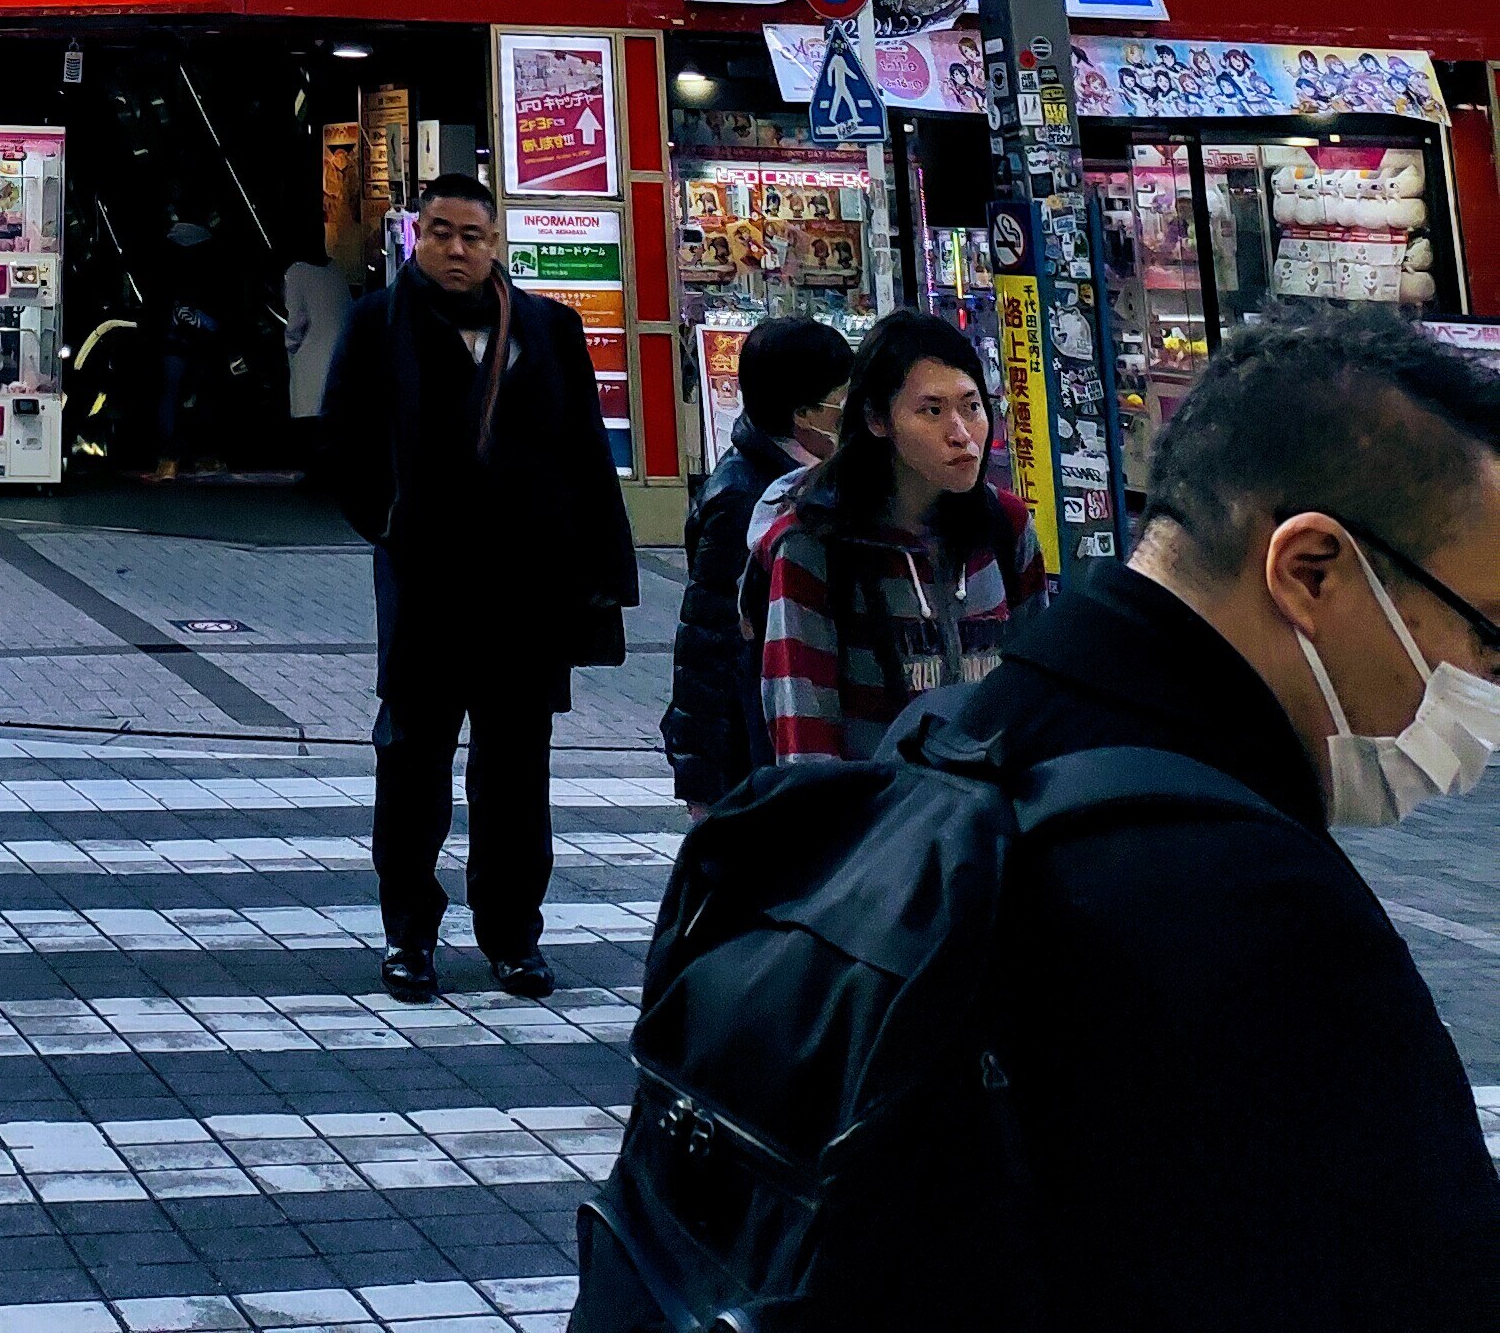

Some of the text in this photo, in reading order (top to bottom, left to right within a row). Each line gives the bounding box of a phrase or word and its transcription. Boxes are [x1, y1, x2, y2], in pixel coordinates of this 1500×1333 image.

[516, 99, 542, 114] UFO
[524, 215, 600, 228] INFORMATION
[1023, 285, 1041, 373] 千代田区内は
